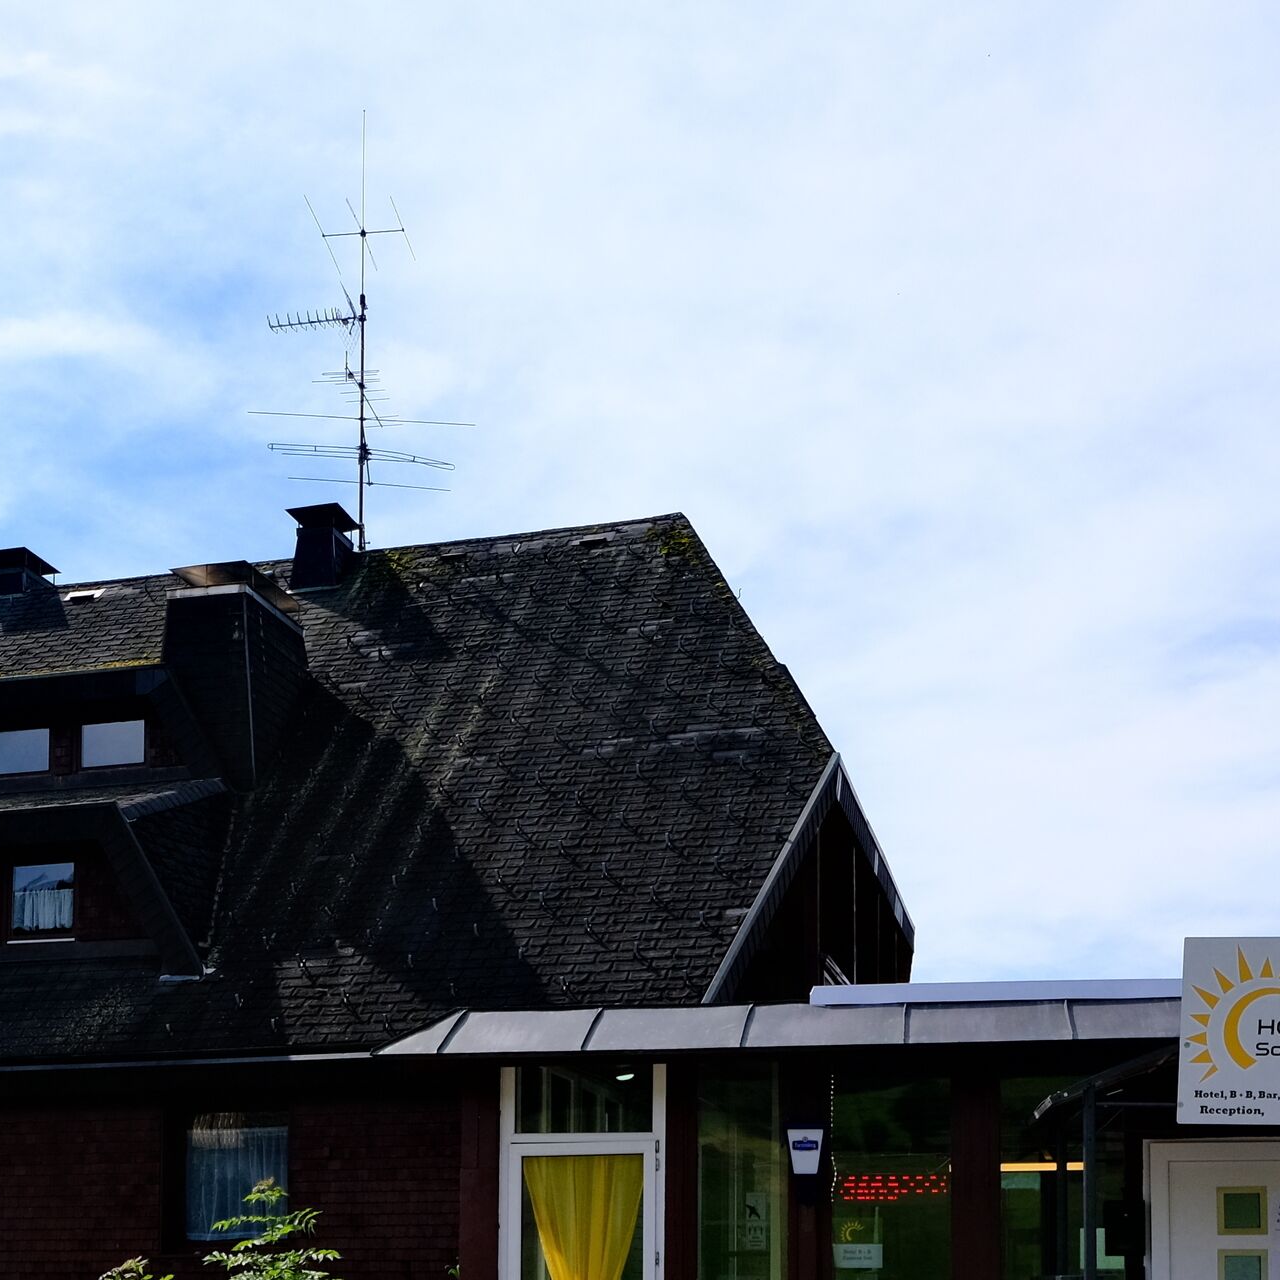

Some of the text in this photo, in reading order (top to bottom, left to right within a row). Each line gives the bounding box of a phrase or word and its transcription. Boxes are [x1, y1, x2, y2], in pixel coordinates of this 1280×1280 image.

[1194, 1090, 1228, 1100] Hotel,
[1229, 1090, 1238, 1099] B
[1258, 1091, 1280, 1100] Bar,
[1199, 1105, 1265, 1117] Reception,
